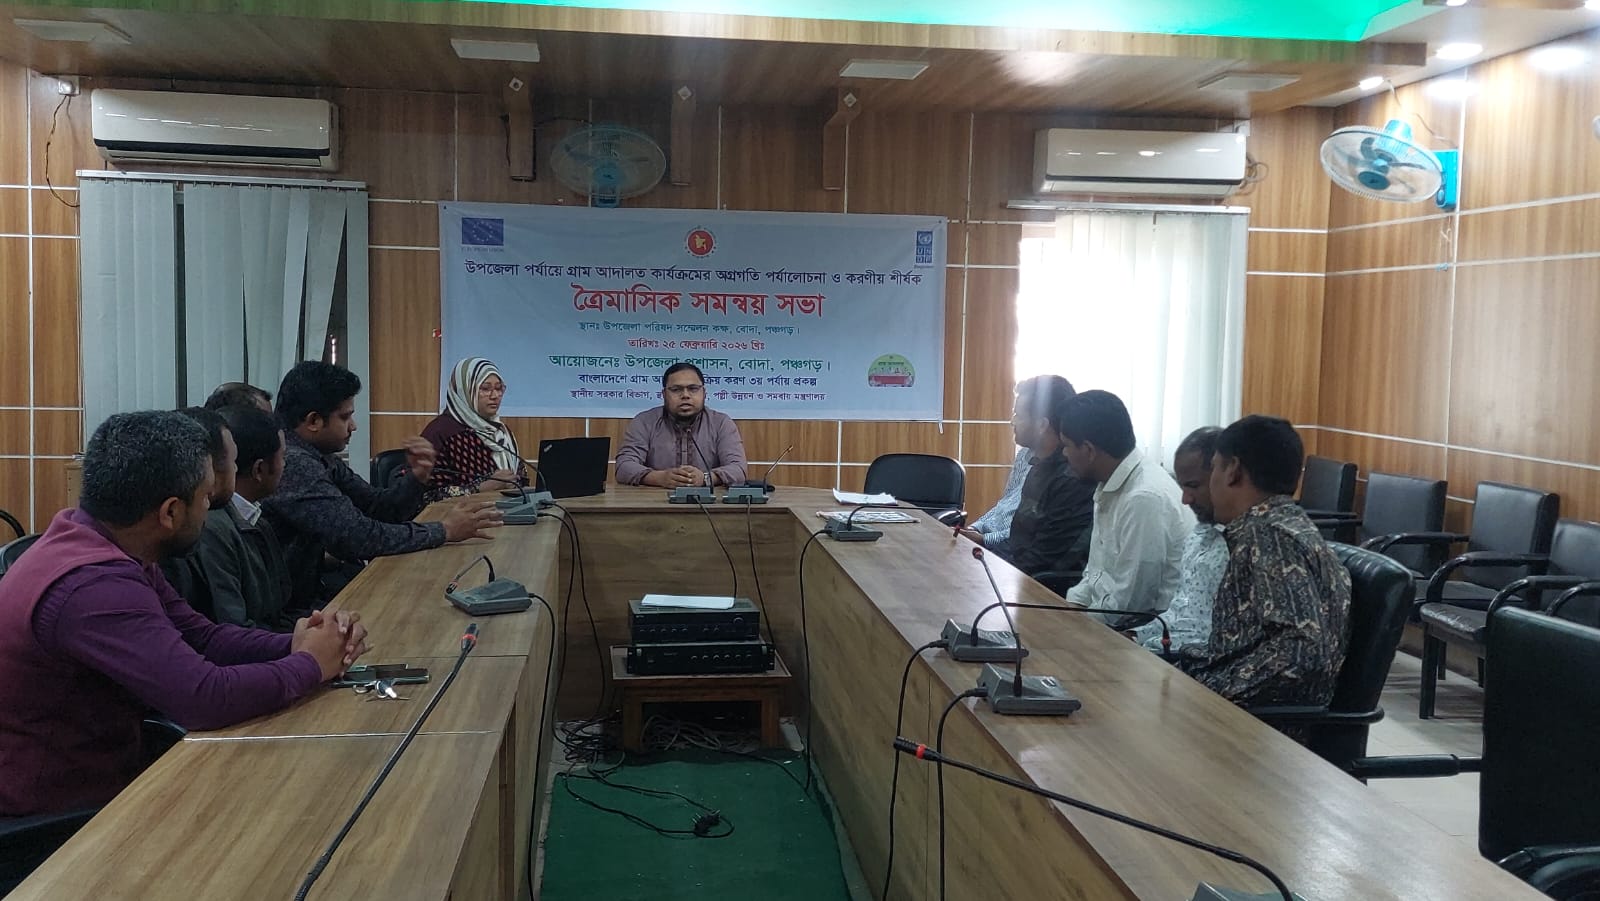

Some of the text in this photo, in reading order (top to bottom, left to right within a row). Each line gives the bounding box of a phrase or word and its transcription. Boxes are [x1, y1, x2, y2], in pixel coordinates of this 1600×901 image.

[465, 260, 923, 286] উপজেলা পর্যায়ে গ্রাম আদালত কার্যক্রমের অগ্রগতি পর্যালোচনা ও করণীয় শীর্ষক
[571, 282, 826, 317] ত্রৈমাসিক সমন্বয় সভা
[603, 320, 641, 331] উপজেলা
[644, 321, 673, 332] পরিষদ
[676, 323, 709, 333] সম্মেলন
[662, 340, 677, 349] ২৫
[721, 341, 748, 351] ২০২৬
[624, 353, 680, 368] উপজেলা
[738, 358, 774, 372] বোদা,
[578, 374, 627, 384] বাংলাদেশে
[630, 373, 649, 384] গ্রাম
[723, 375, 746, 386] করণ
[748, 376, 763, 386] ৩য়
[767, 374, 790, 386] পর্যায়
[793, 376, 817, 387] প্রকল্প
[570, 387, 594, 399] স্থানীয়
[596, 390, 624, 399] সরকার
[758, 392, 764, 400] ও
[767, 392, 791, 400] সমবায়
